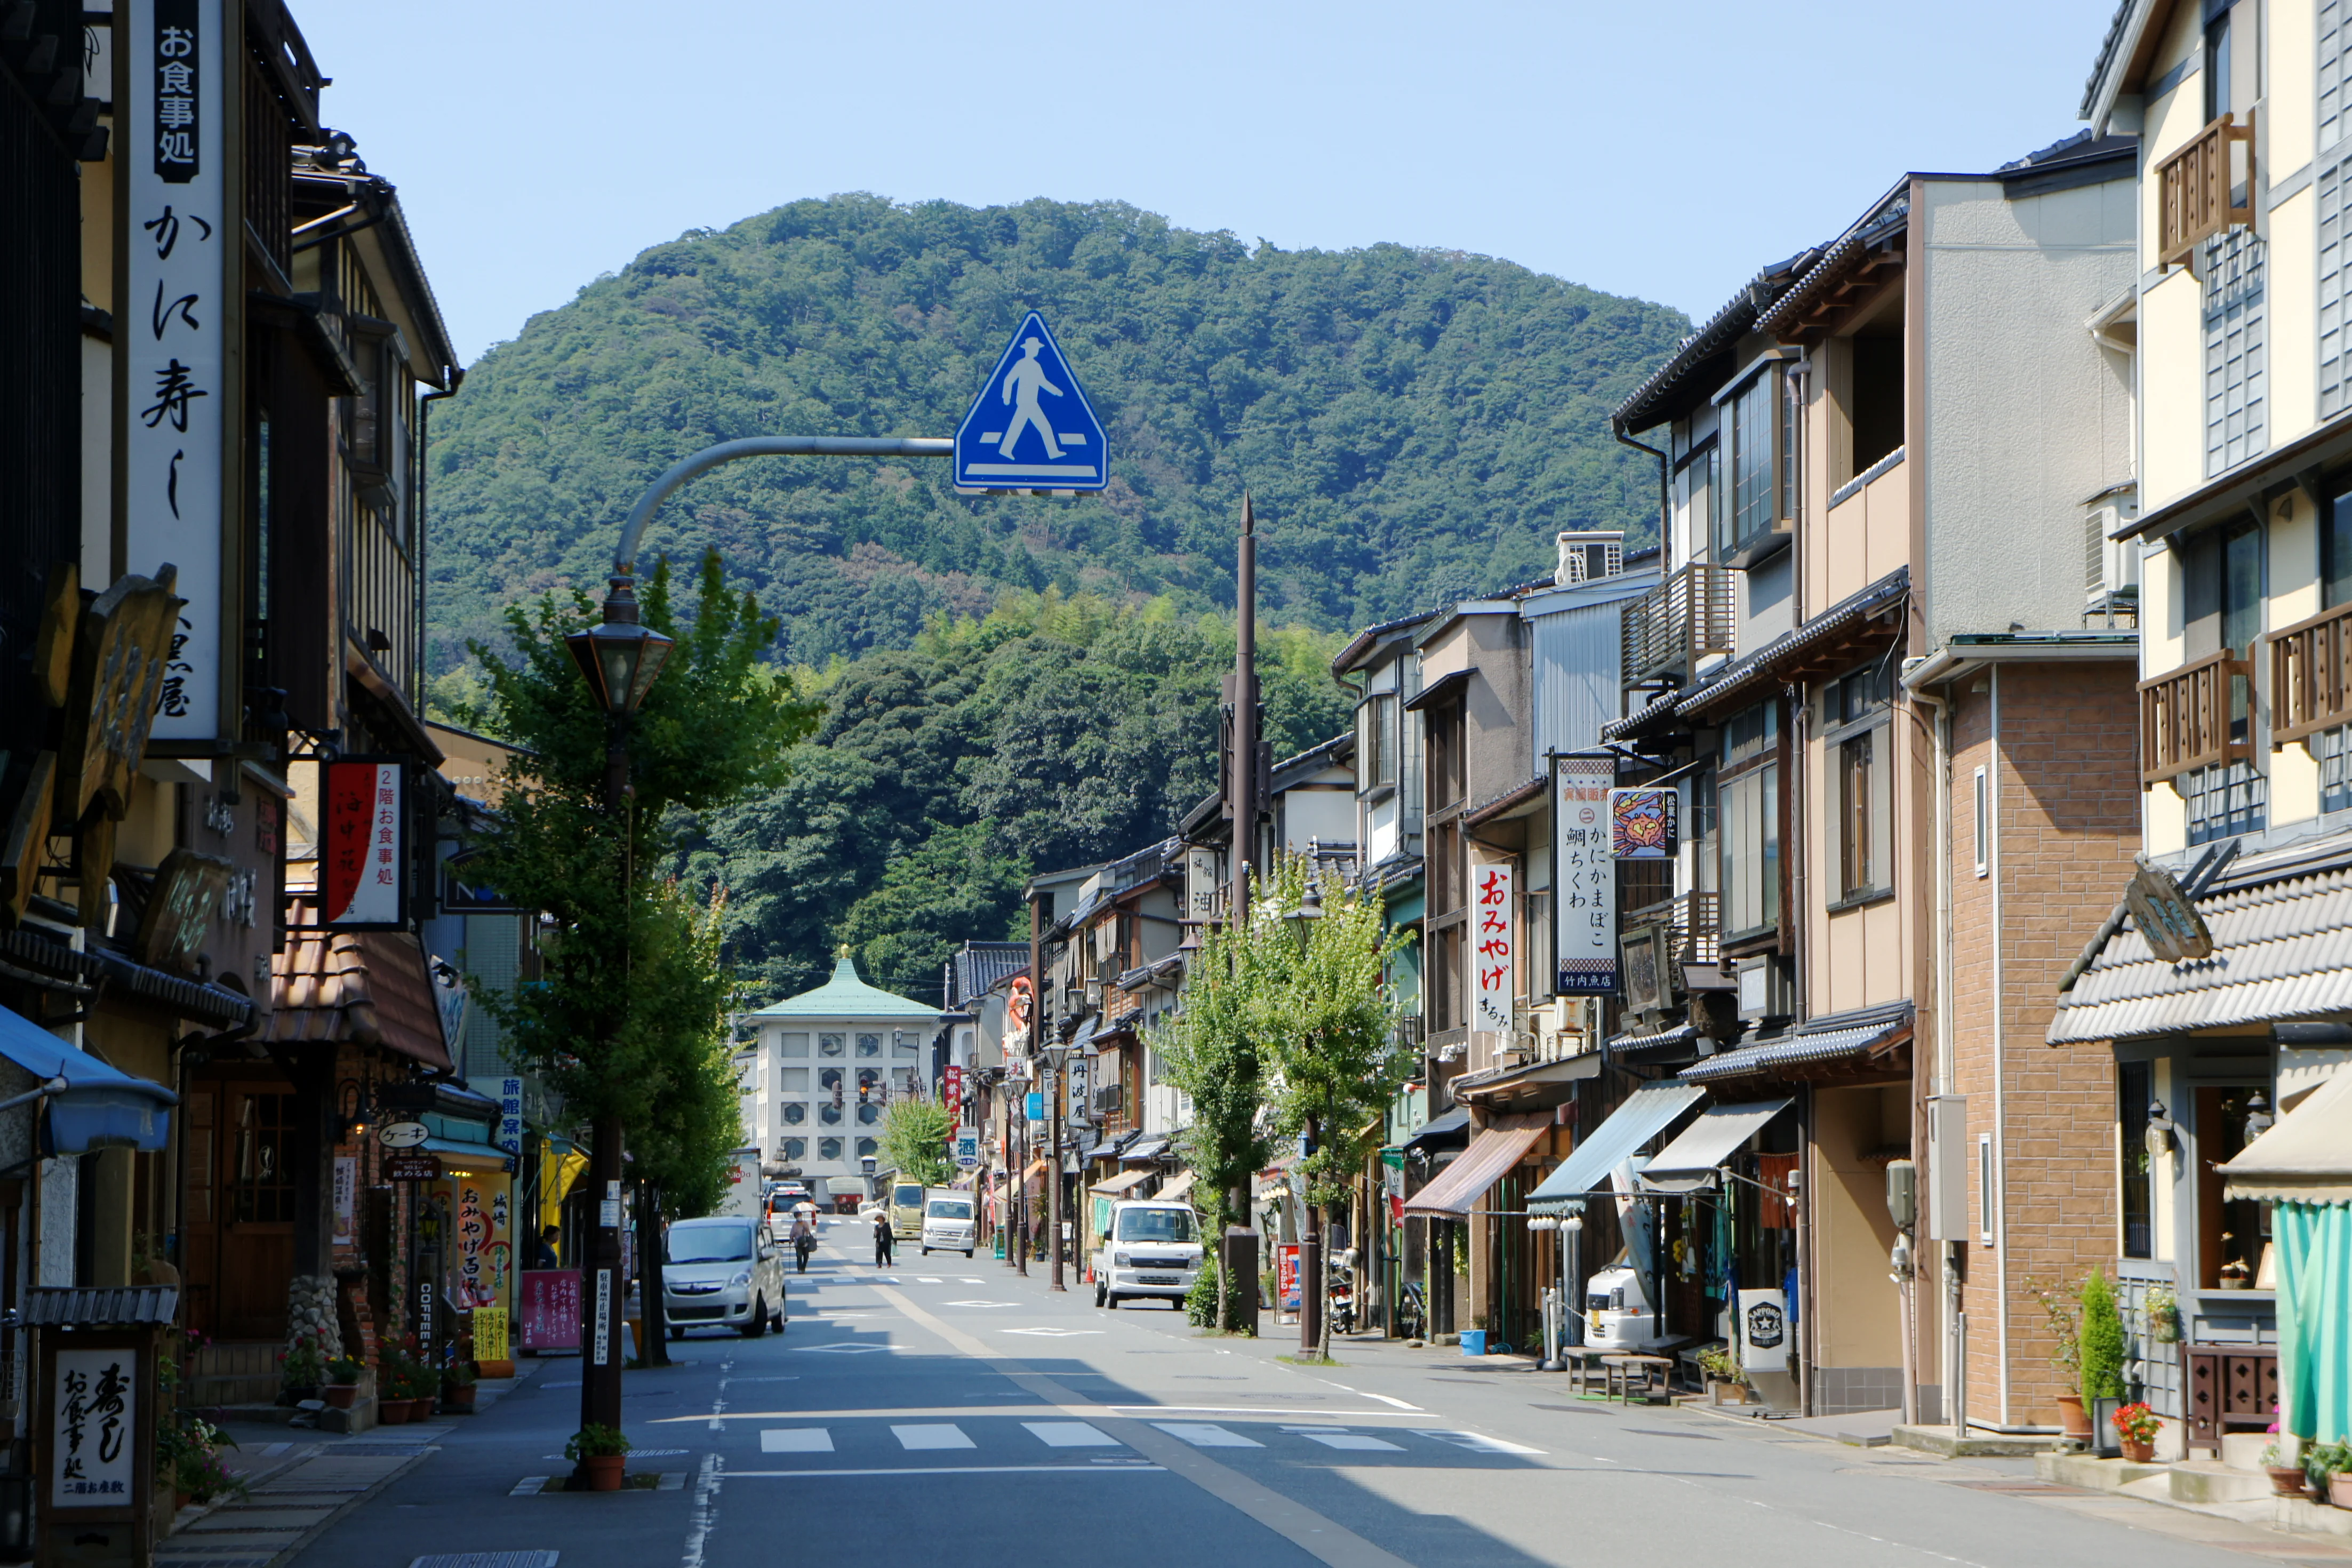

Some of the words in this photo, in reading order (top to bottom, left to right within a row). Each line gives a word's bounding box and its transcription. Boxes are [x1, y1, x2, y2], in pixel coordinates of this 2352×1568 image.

[159, 26, 194, 164] お食事処
[141, 205, 211, 519] かに寿し
[377, 770, 395, 885] 2階お食事処
[1667, 795, 1676, 838] 松葉かに
[1194, 857, 1213, 878] 旅館
[1566, 828, 1586, 908] 鯛ちくわ
[1590, 827, 1608, 947] かにかまぼこ
[1478, 870, 1509, 992] おみやげ
[1564, 974, 1611, 987] 竹内魚店
[1478, 997, 1509, 1027] まるみ
[1071, 1065, 1087, 1118] 丹波屋
[382, 1127, 424, 1142] ケーキ
[958, 1138, 977, 1156] 酒
[492, 1194, 508, 1226] 城崎
[420, 1283, 431, 1340] COFFEE
[598, 1273, 608, 1331] 駐車禁止場所
[1749, 1307, 1780, 1320] SAPPORO
[62, 1370, 87, 1479] お食事処
[63, 1481, 125, 1494] 二階お座敷
